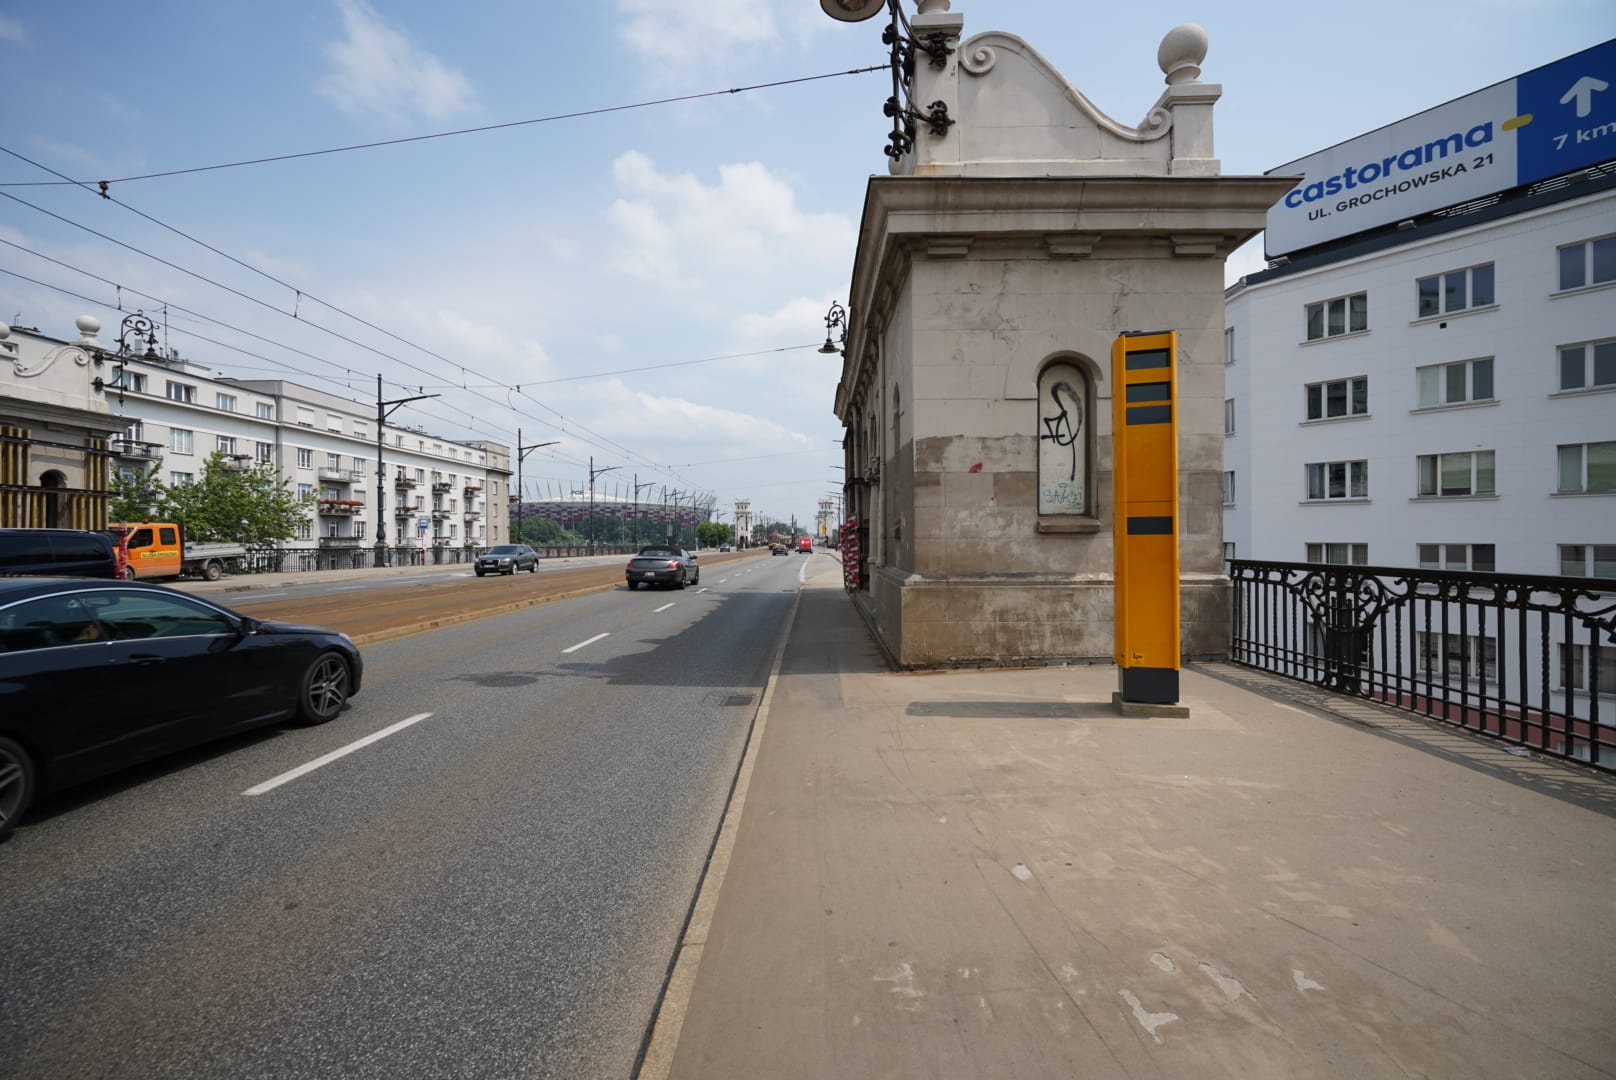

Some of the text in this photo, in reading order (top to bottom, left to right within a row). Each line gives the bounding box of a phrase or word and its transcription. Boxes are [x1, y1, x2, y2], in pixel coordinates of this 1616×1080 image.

[1285, 121, 1493, 209] castorama
[1553, 122, 1616, 150] 7 km
[1308, 153, 1494, 221] UL. GROCHOWSKA 21
